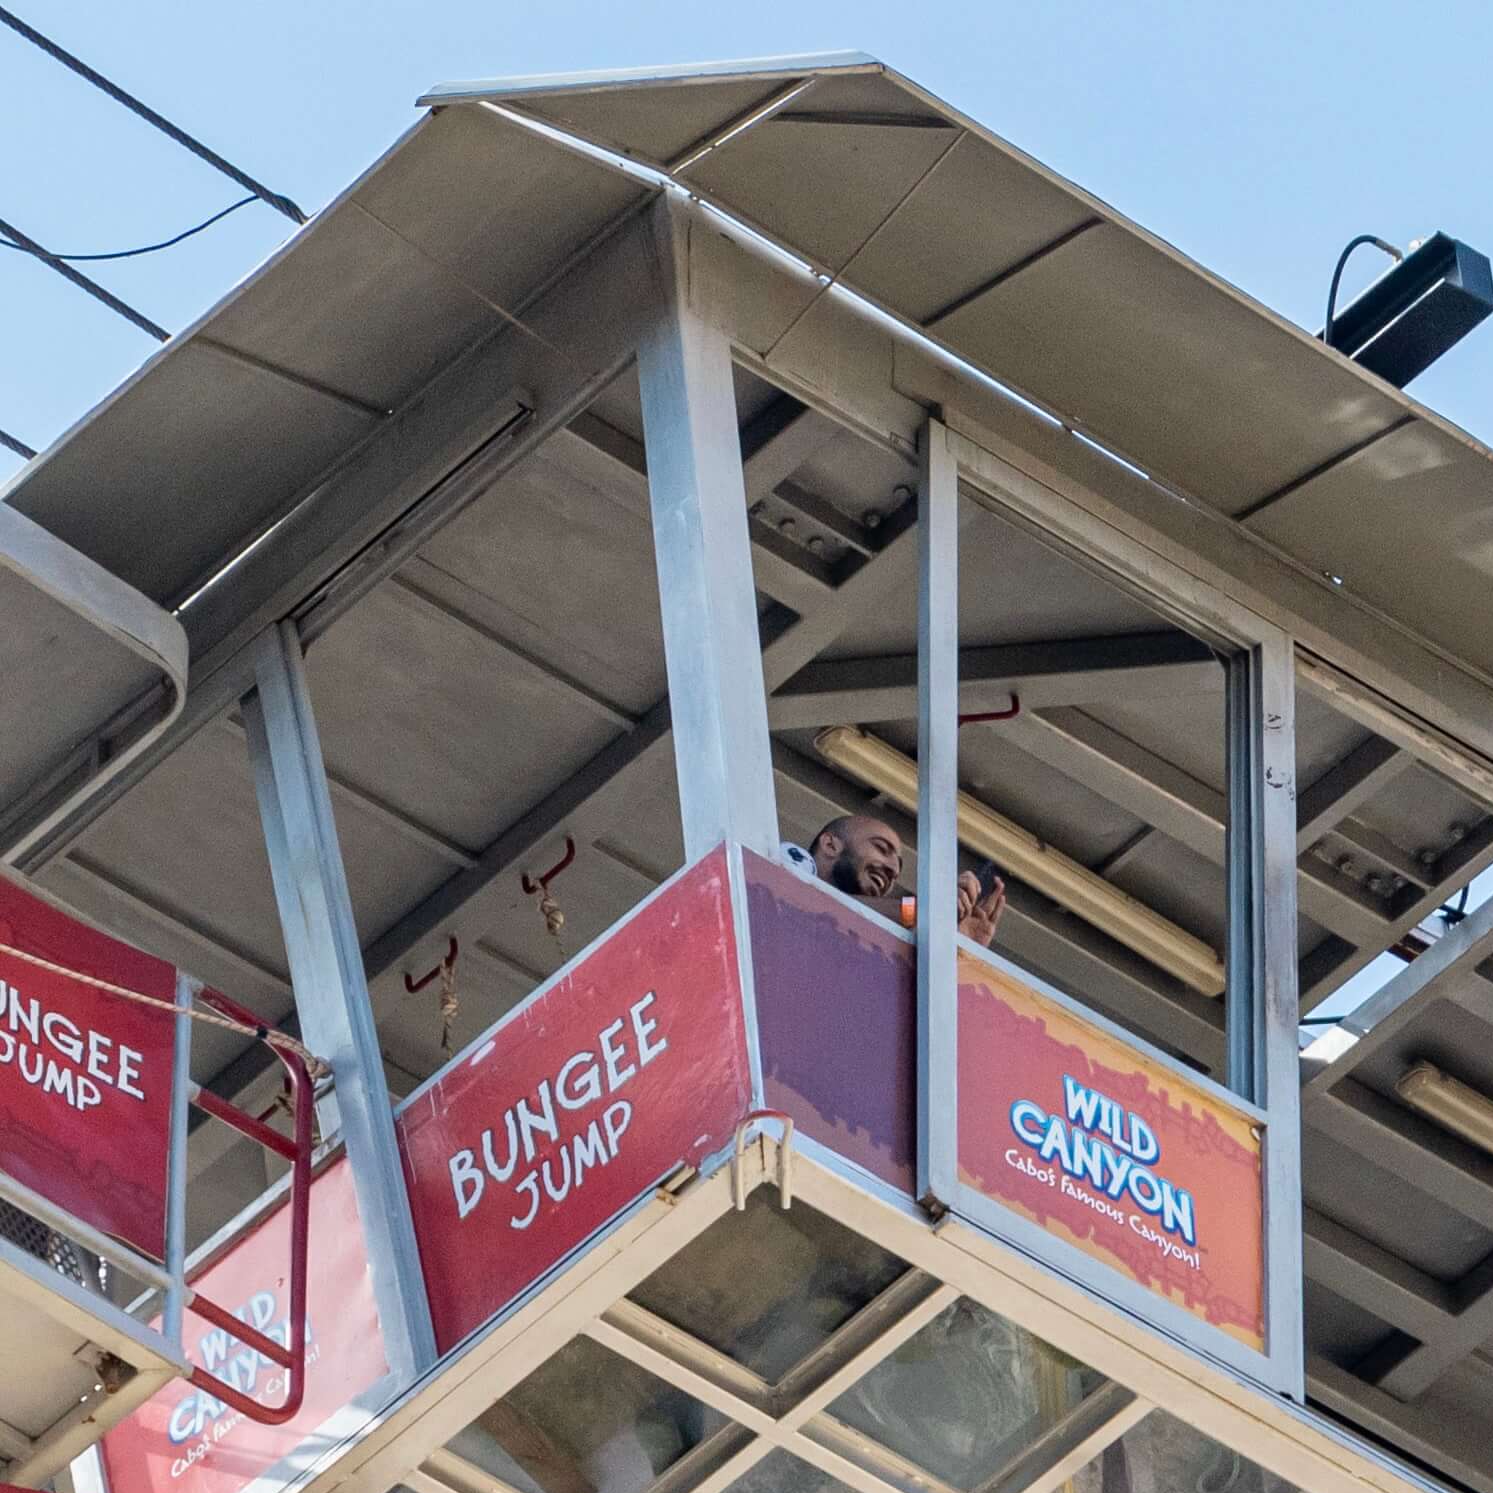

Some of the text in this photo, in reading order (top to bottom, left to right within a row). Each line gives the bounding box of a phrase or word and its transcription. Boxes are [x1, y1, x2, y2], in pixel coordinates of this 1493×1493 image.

[0, 979, 145, 1101] NGEE
[448, 990, 669, 1220] BUNGEE
[510, 1099, 633, 1230] JUMP
[1063, 1072, 1161, 1166] WILD
[1004, 1149, 1056, 1188] Cabo's
[1128, 1214, 1201, 1271] Canyon!
[1009, 1099, 1197, 1248] CANYON
